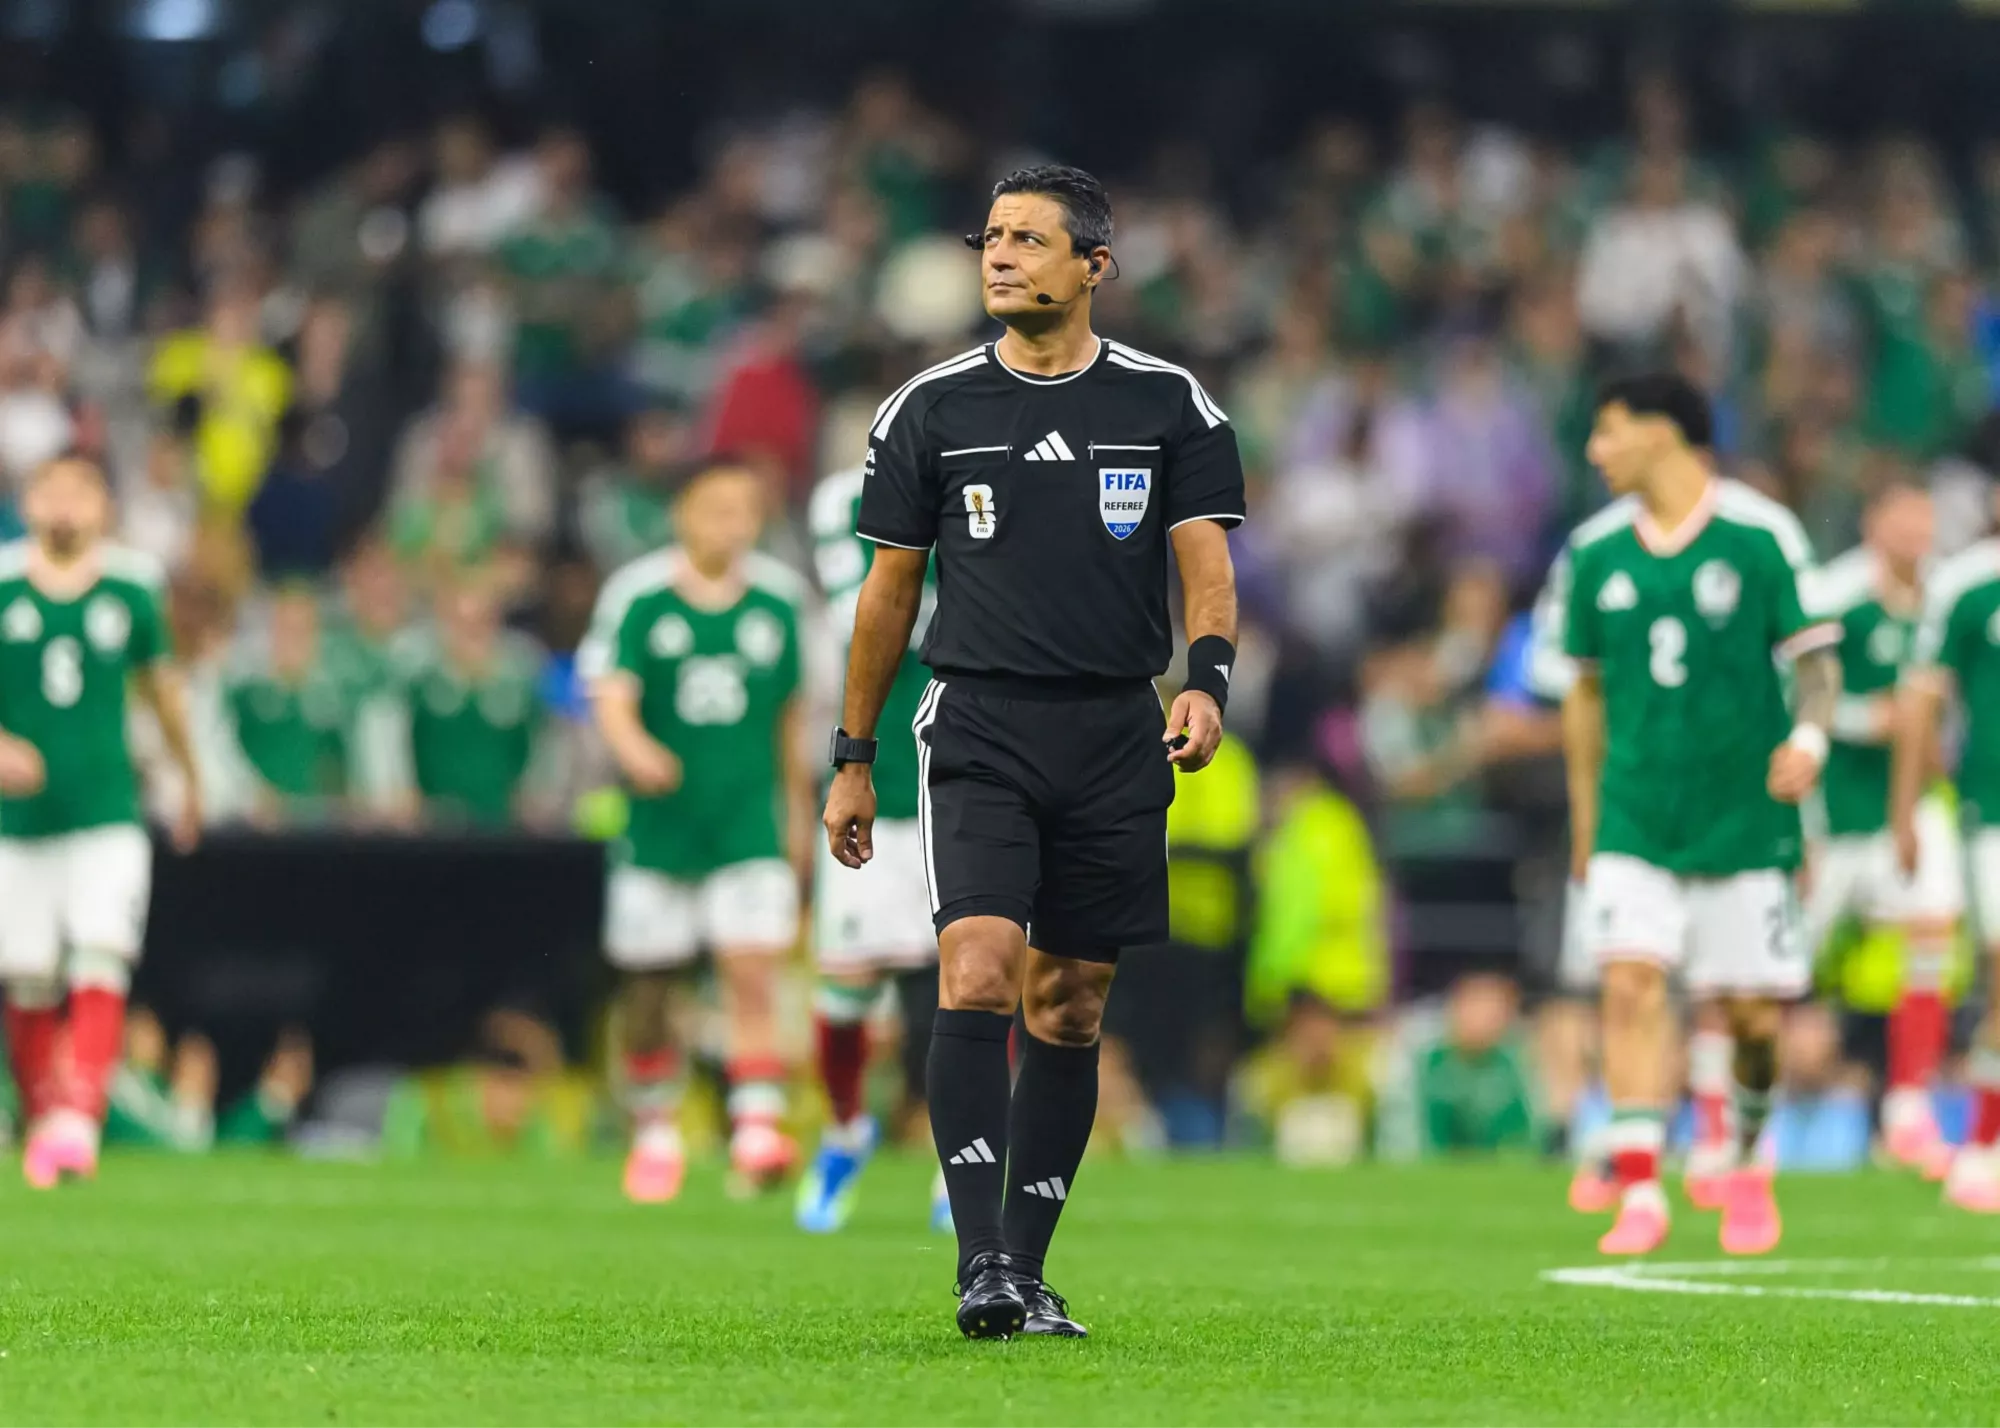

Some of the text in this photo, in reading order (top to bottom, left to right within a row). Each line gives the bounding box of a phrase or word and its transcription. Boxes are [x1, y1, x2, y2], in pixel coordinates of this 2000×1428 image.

[1105, 473, 1147, 490] FIFA
[1104, 502, 1144, 511] REFEREE
[1114, 525, 1131, 533] 2026
[1648, 615, 1689, 688] 2
